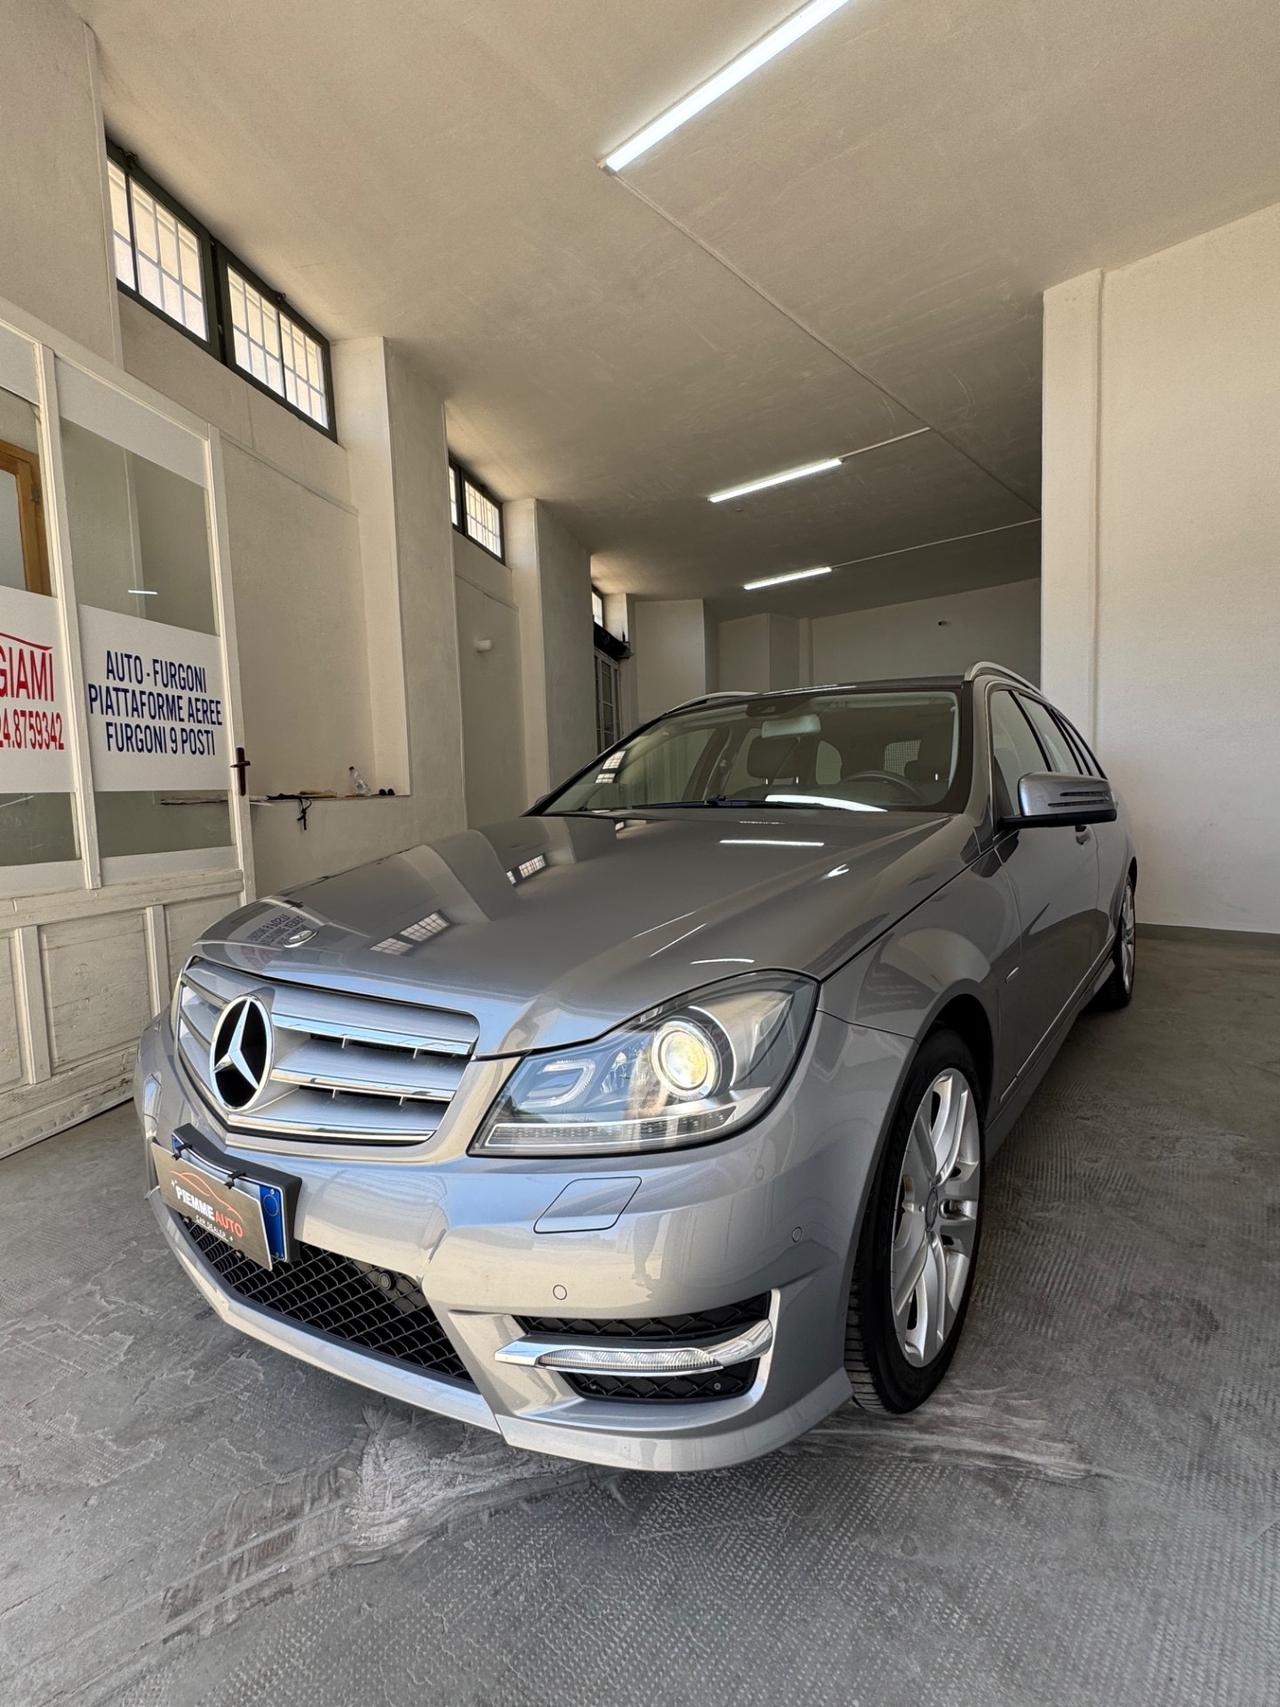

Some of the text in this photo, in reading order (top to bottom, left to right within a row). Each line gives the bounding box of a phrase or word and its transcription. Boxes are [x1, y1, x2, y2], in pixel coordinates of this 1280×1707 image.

[106, 650, 143, 685] AUTO
[152, 659, 207, 693] FURGONI
[88, 683, 223, 726] PIATTAFORME AEREE
[106, 722, 216, 756] FURGONI 9 POSTI
